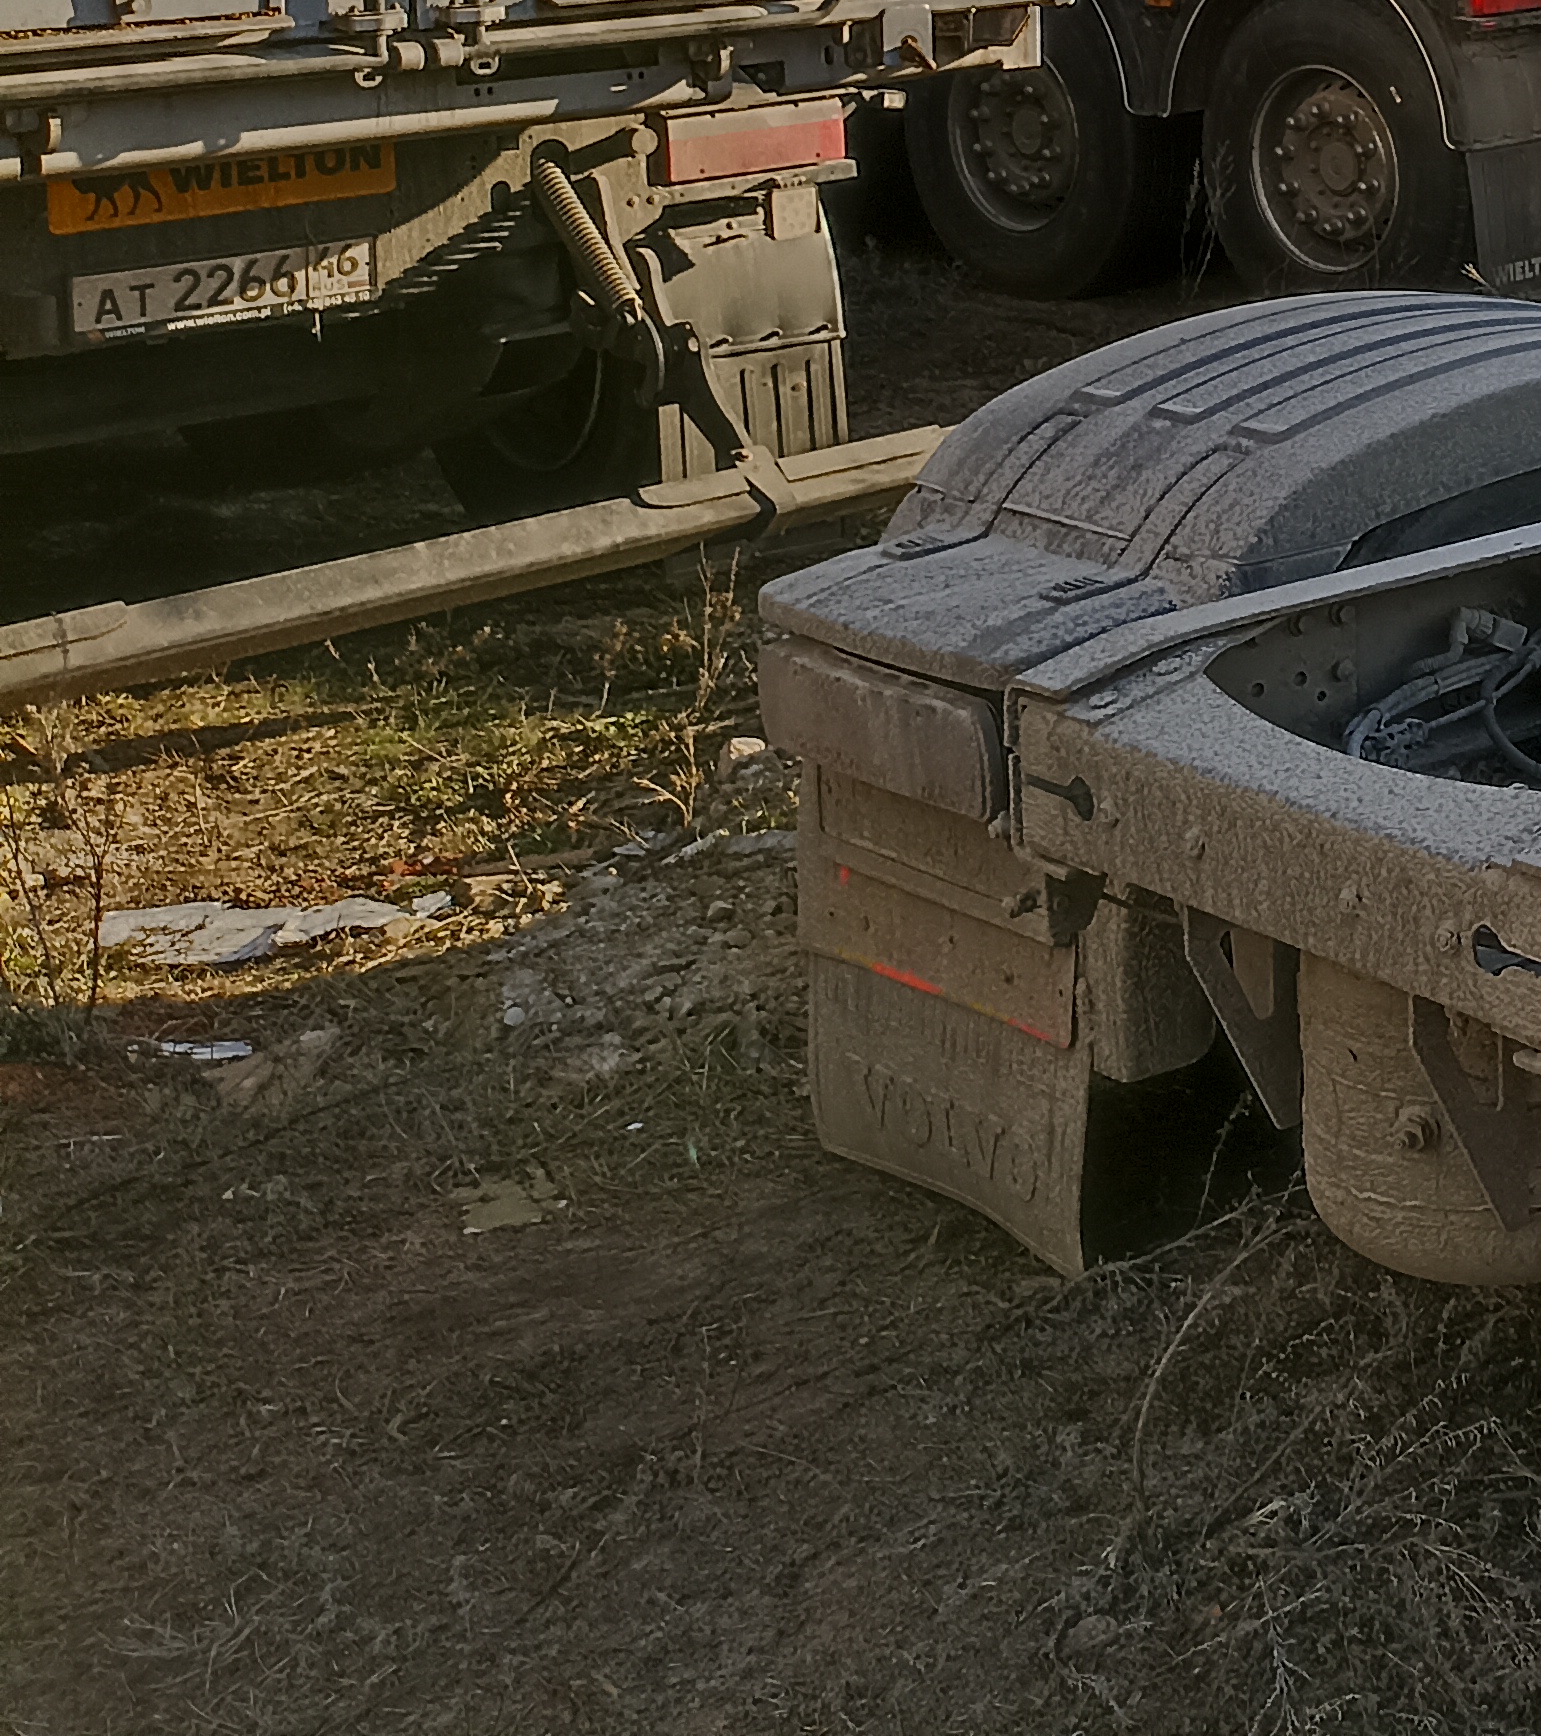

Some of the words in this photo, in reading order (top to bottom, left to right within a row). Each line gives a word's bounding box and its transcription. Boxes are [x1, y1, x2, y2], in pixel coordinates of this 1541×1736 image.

[169, 143, 383, 194] WIELTON
[95, 282, 155, 324] AT
[173, 254, 298, 313] 2266
[313, 243, 360, 279] 46
[864, 1065, 1038, 1203] VOLVO
